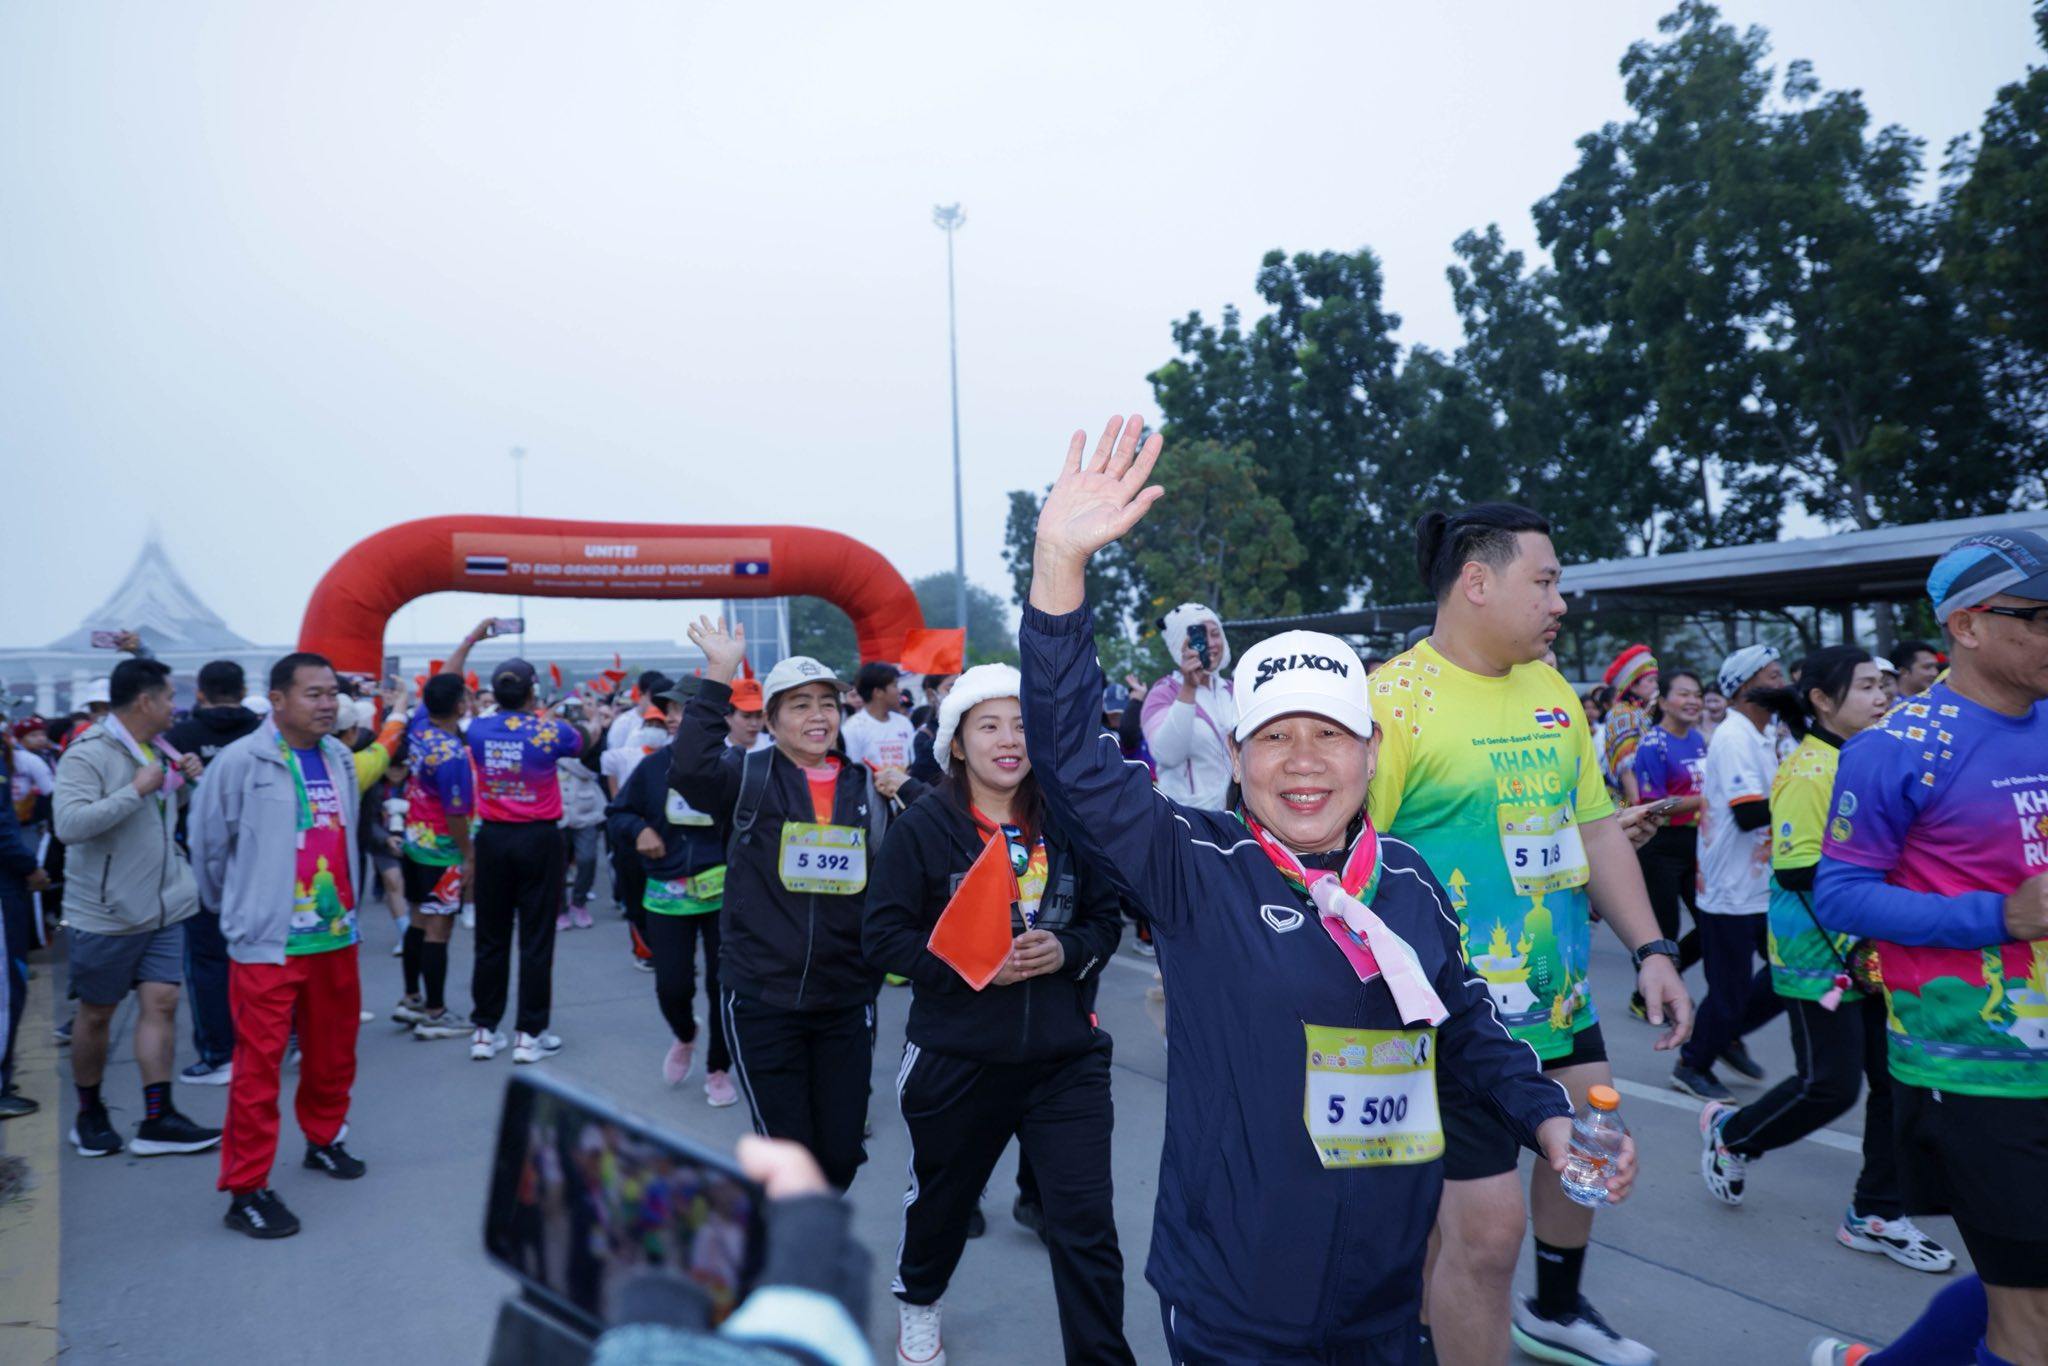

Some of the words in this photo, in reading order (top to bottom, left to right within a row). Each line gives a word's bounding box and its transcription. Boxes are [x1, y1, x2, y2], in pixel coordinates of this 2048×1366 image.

[511, 563, 531, 575] TO
[534, 564, 562, 575] END
[563, 564, 666, 576] GENDER-BASED
[668, 564, 731, 576] VIOLENCE
[1253, 654, 1348, 693] SRIXON
[1472, 738, 1486, 746] End
[1489, 746, 1560, 774] KHAM
[798, 853, 808, 867] 5
[817, 854, 849, 870] 392
[1515, 848, 1528, 867] 5
[1327, 1094, 1346, 1124] 5
[1359, 1094, 1408, 1125] 500
